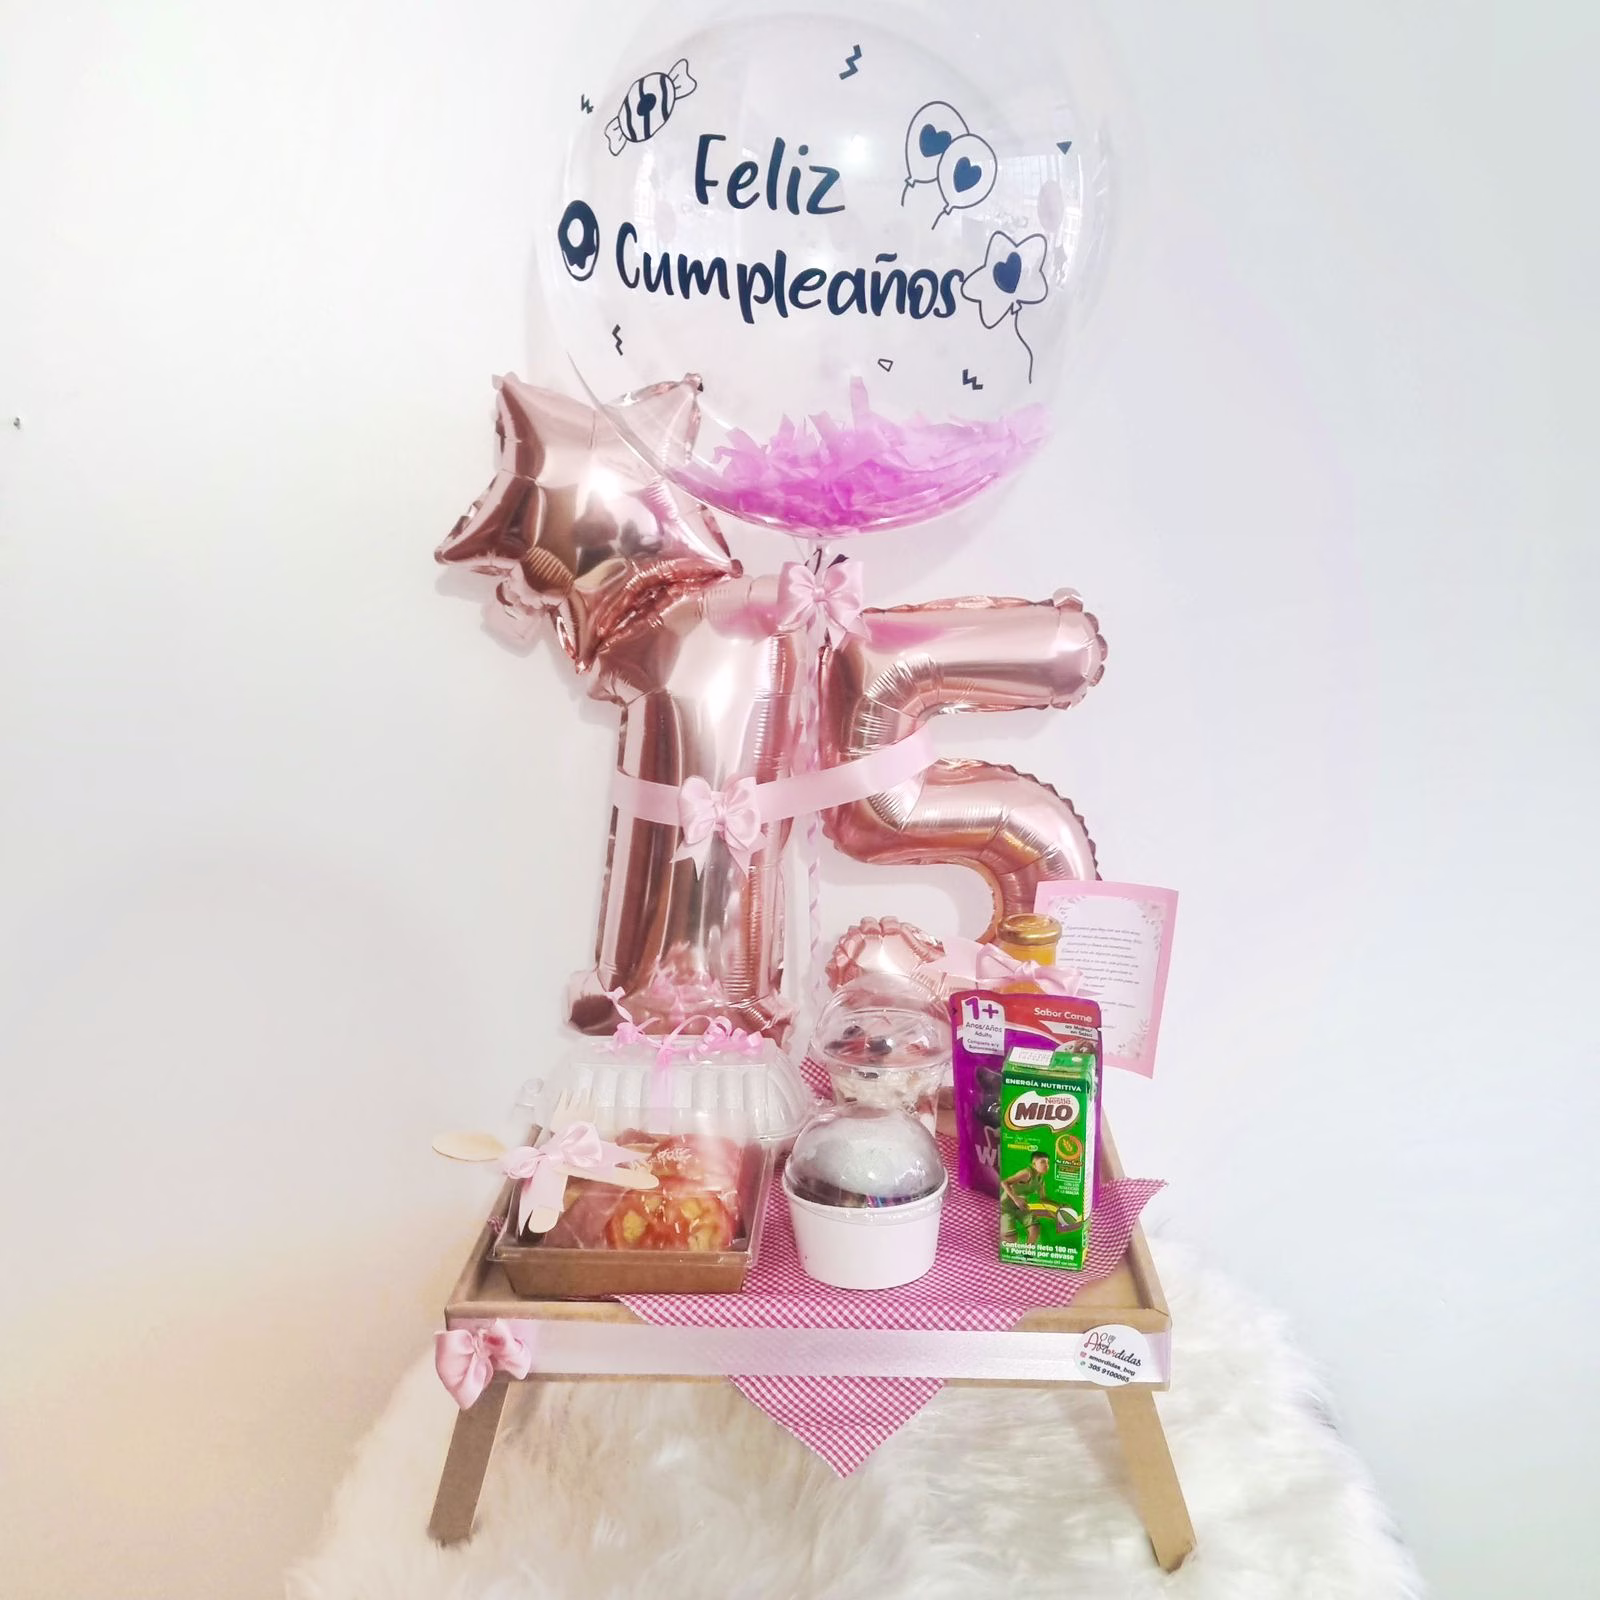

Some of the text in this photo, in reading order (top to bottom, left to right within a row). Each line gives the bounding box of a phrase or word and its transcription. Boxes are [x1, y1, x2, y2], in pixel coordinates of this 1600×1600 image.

[694, 133, 845, 216] Feliz
[615, 221, 964, 324] Cumpleaños
[965, 996, 999, 1020] 1+
[1034, 1007, 1093, 1023] Sabor Carne
[1005, 1077, 1082, 1092] ENERGÍA NUTRITIVA
[1014, 1102, 1073, 1121] MILO
[1001, 1240, 1036, 1250] Contenido
[1037, 1244, 1054, 1252] Neto
[1055, 1245, 1067, 1253] 180
[1010, 1248, 1036, 1256] Porción
[1050, 1253, 1075, 1261] envase
[1088, 1363, 1101, 1372] 305
